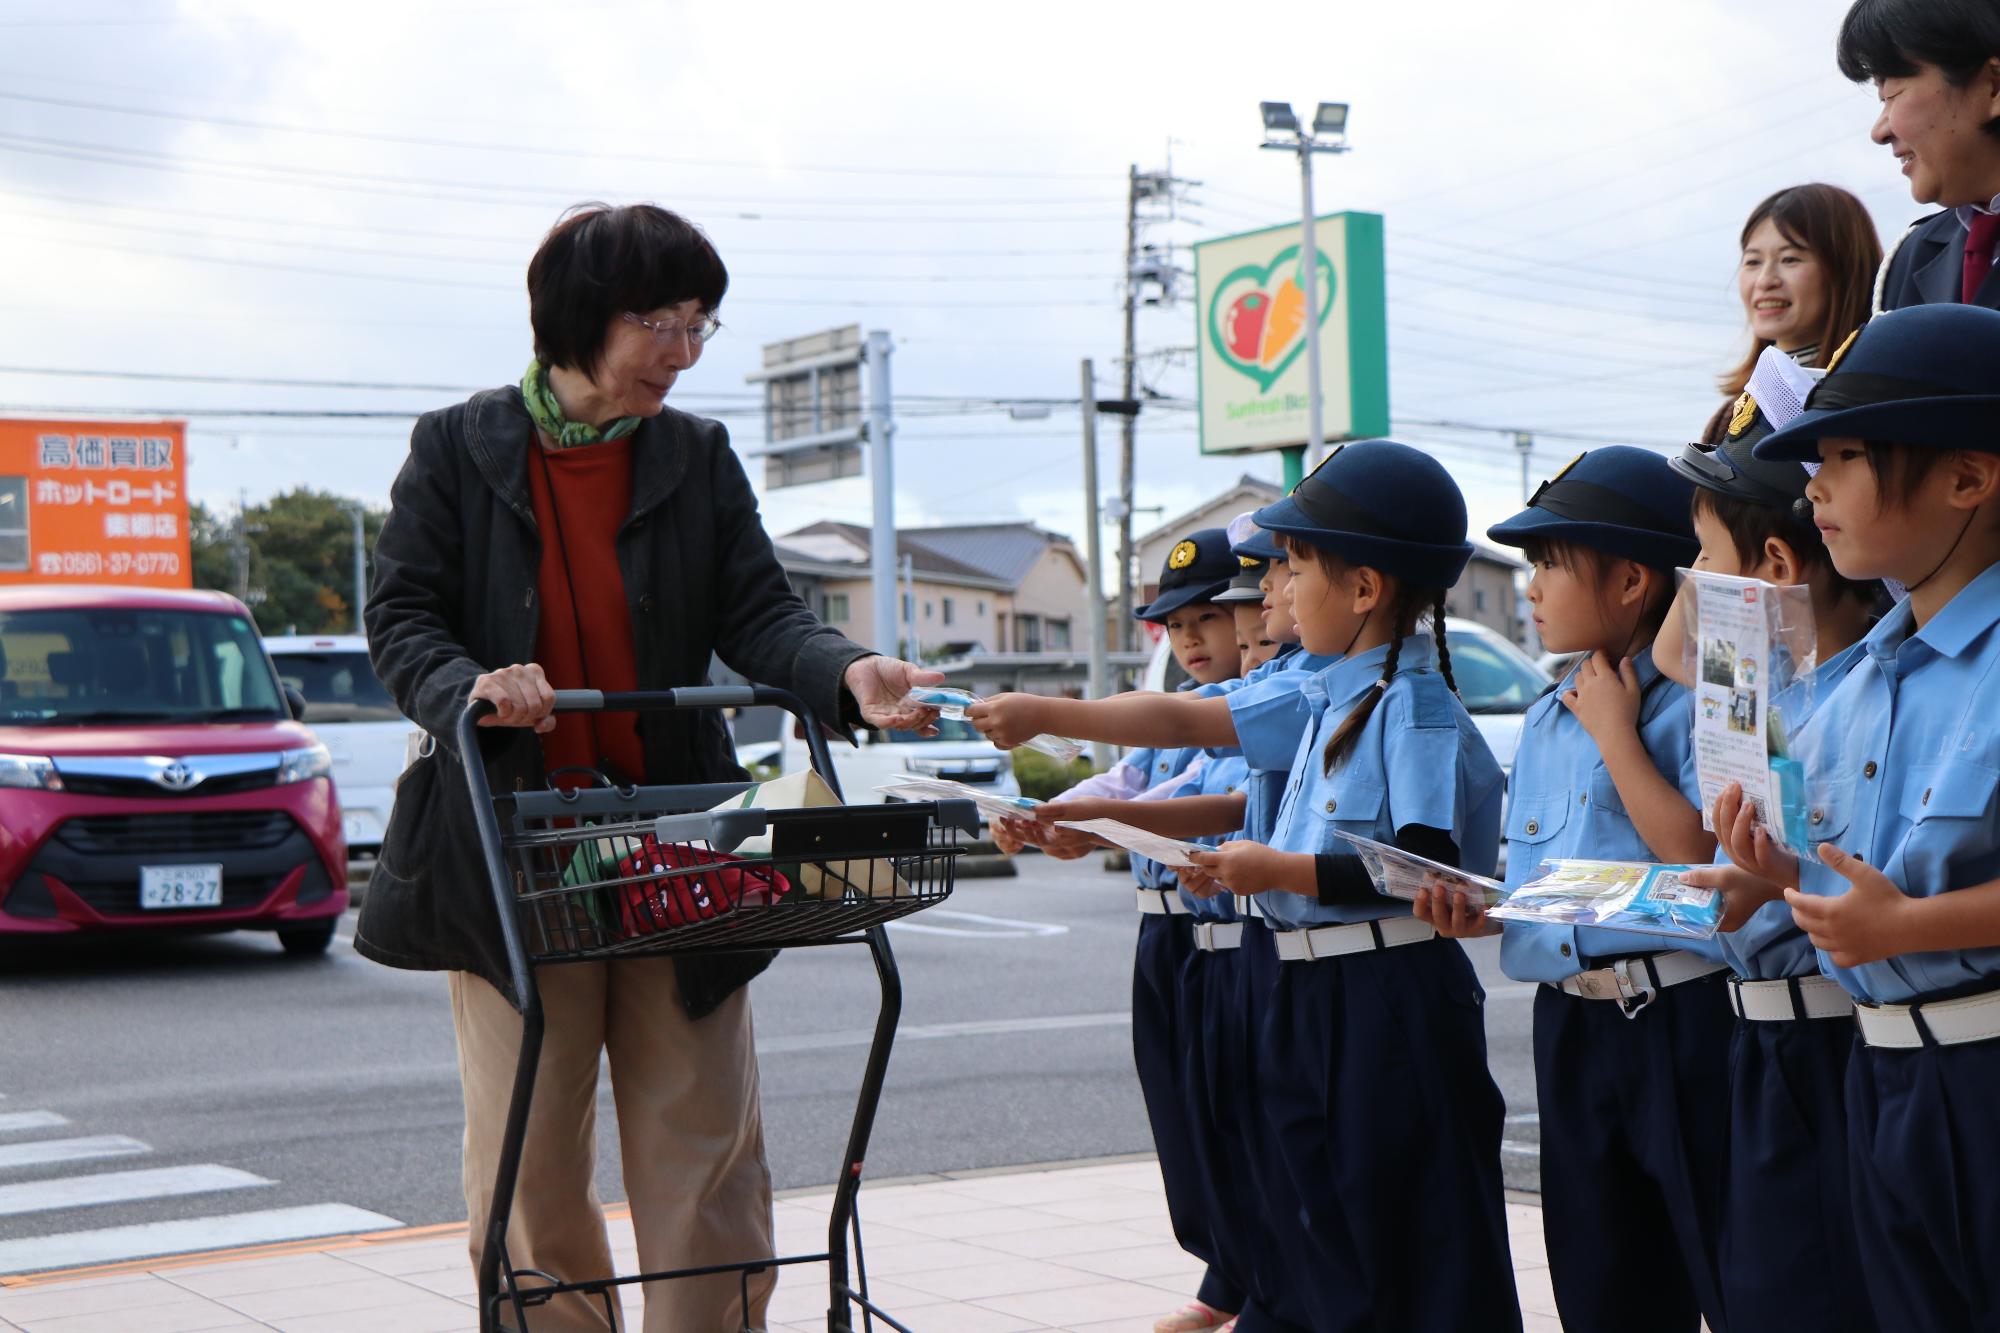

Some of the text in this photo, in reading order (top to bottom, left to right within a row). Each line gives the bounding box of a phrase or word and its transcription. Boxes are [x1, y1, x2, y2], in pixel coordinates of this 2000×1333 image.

[38, 434, 174, 471] 高価買取
[37, 480, 177, 505] ホットロード
